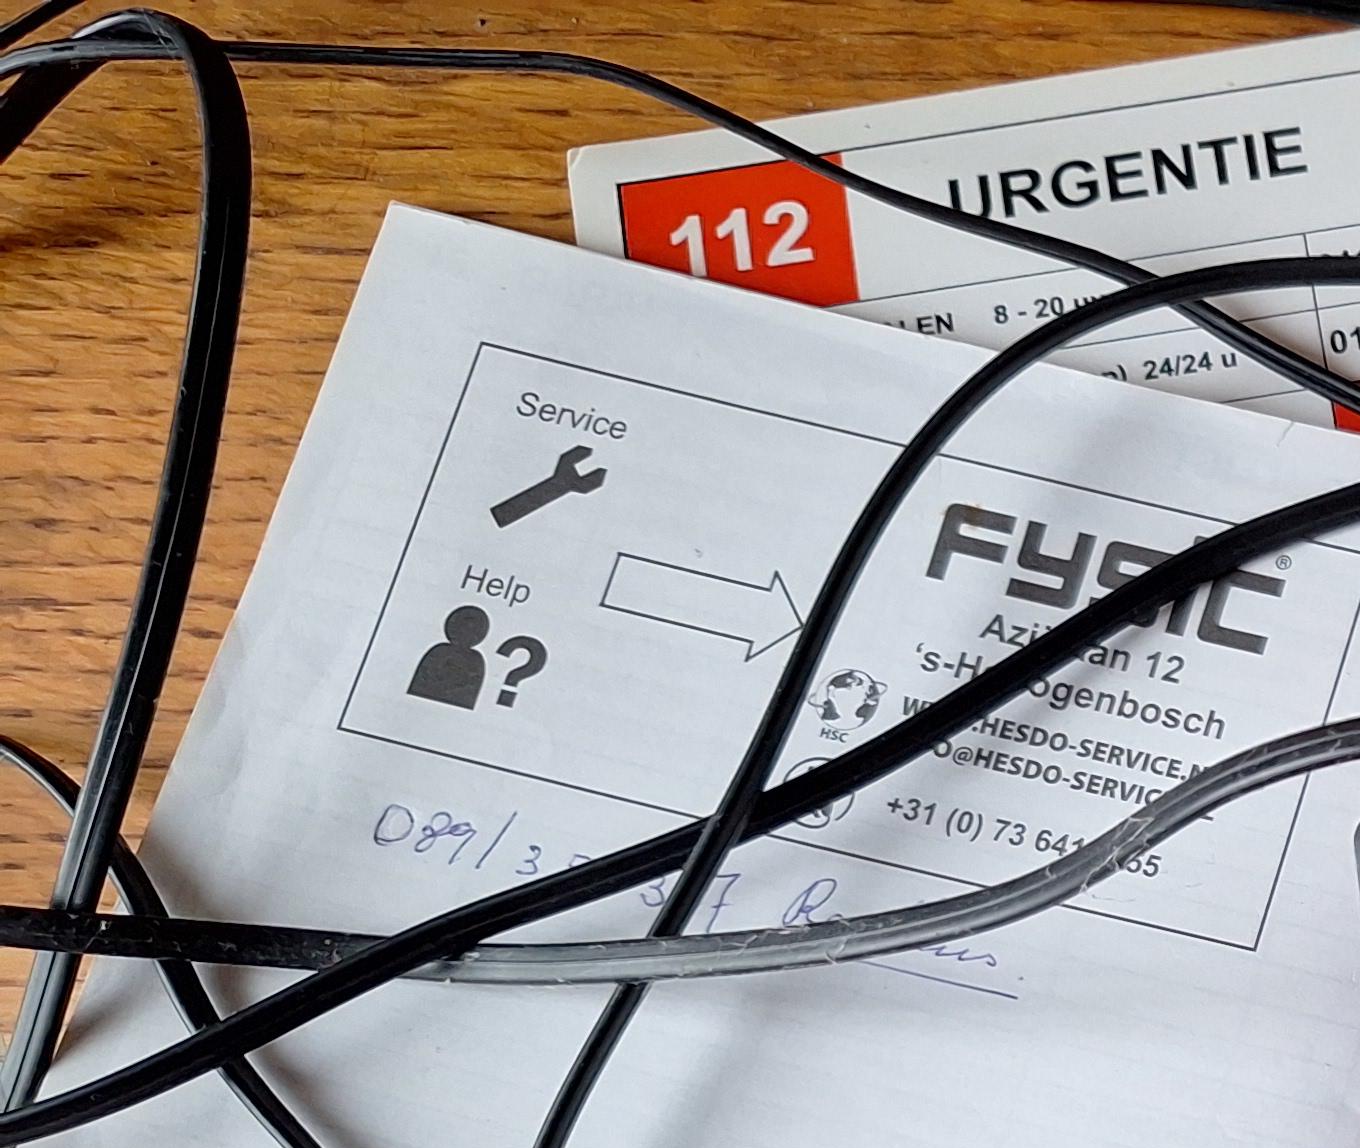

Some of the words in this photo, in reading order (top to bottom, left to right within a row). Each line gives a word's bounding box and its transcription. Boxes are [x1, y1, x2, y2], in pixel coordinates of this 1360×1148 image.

[669, 201, 815, 278] 112
[948, 127, 1307, 219] URGENTIE
[994, 304, 1008, 324] 8
[1034, 296, 1064, 319] 20
[1143, 352, 1212, 380] 24/24
[1221, 353, 1237, 369] u
[516, 391, 628, 440] Service
[460, 564, 531, 607] Help
[1145, 651, 1185, 684] 12
[819, 727, 849, 743] HSC
[887, 797, 937, 826] +31
[946, 807, 984, 842] (0)
[994, 818, 1027, 846] 73
